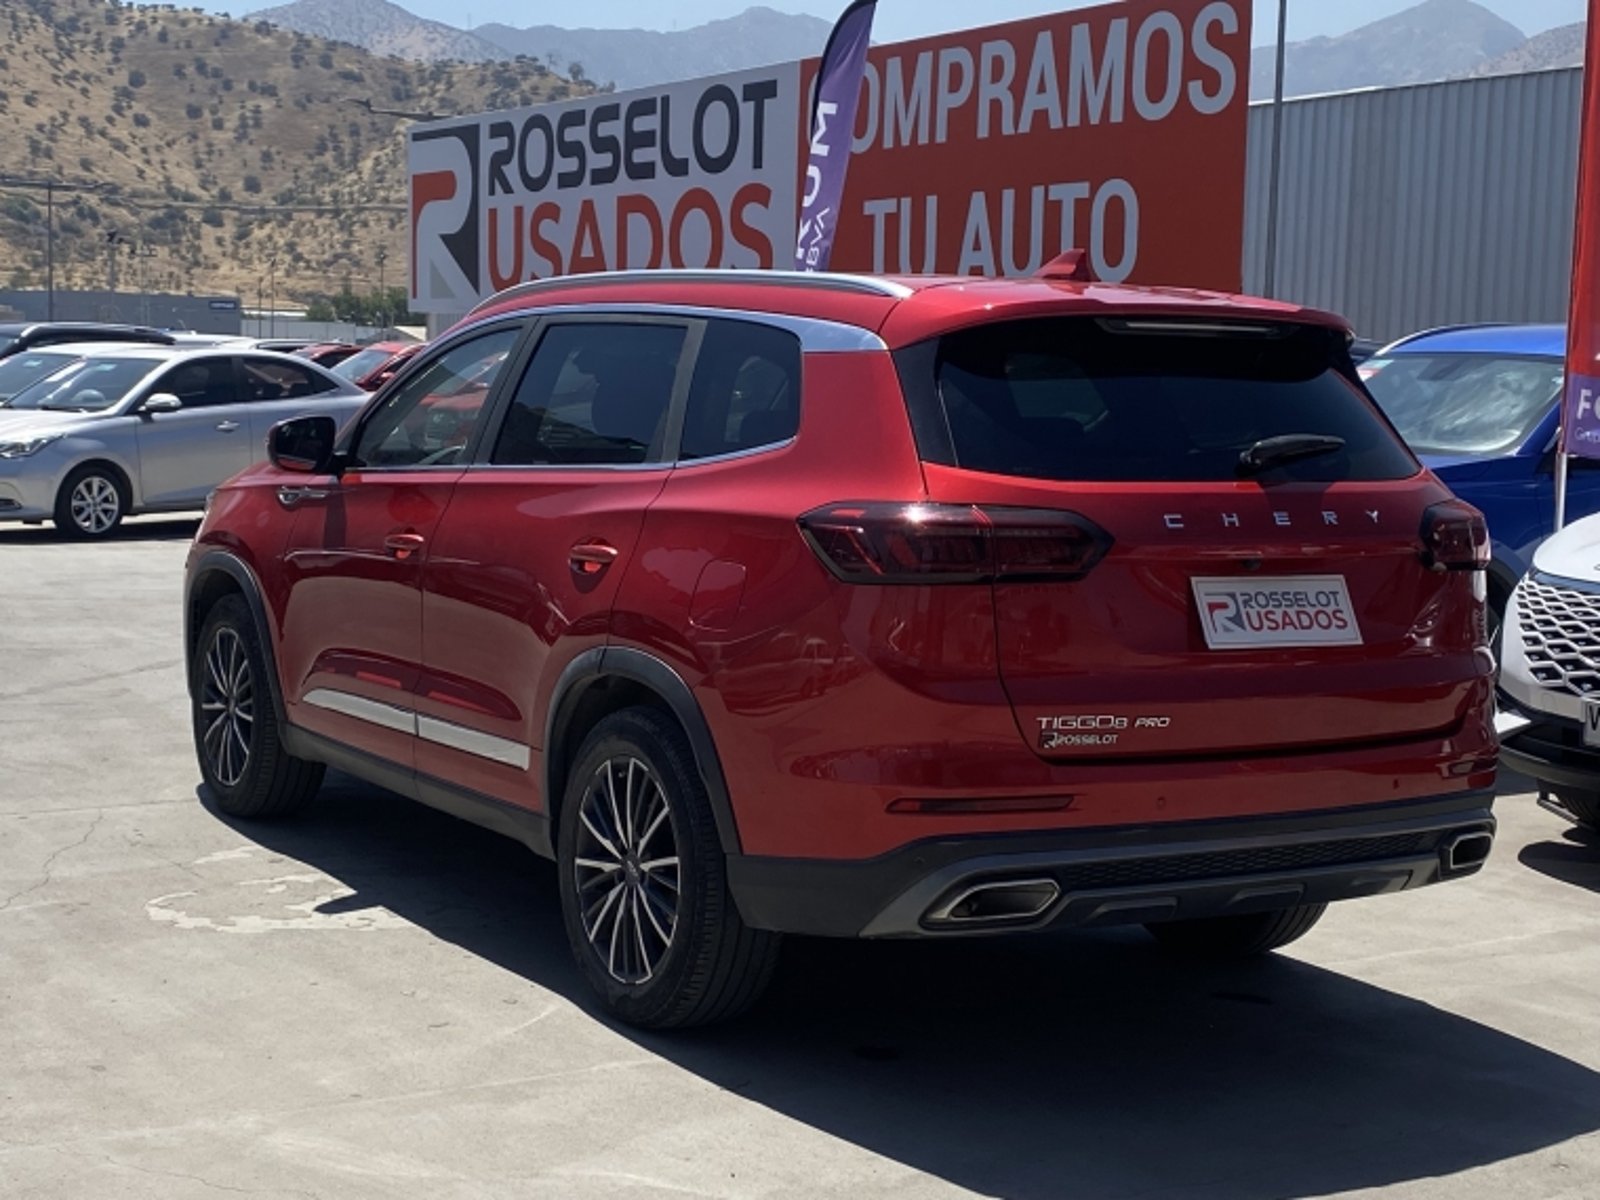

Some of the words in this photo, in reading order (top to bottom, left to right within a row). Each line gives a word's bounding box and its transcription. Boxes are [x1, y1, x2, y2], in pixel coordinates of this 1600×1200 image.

[807, 1, 1239, 155] OMPRAMOS
[487, 78, 779, 197] ROSSELOT
[487, 181, 774, 292] USADOS
[863, 194, 939, 276] TU
[957, 177, 1140, 285] AUTO
[1163, 509, 1380, 528] CHERY
[1239, 590, 1340, 609] ROSSELOT
[1245, 609, 1349, 632] USADOS
[1134, 716, 1172, 728] PRO
